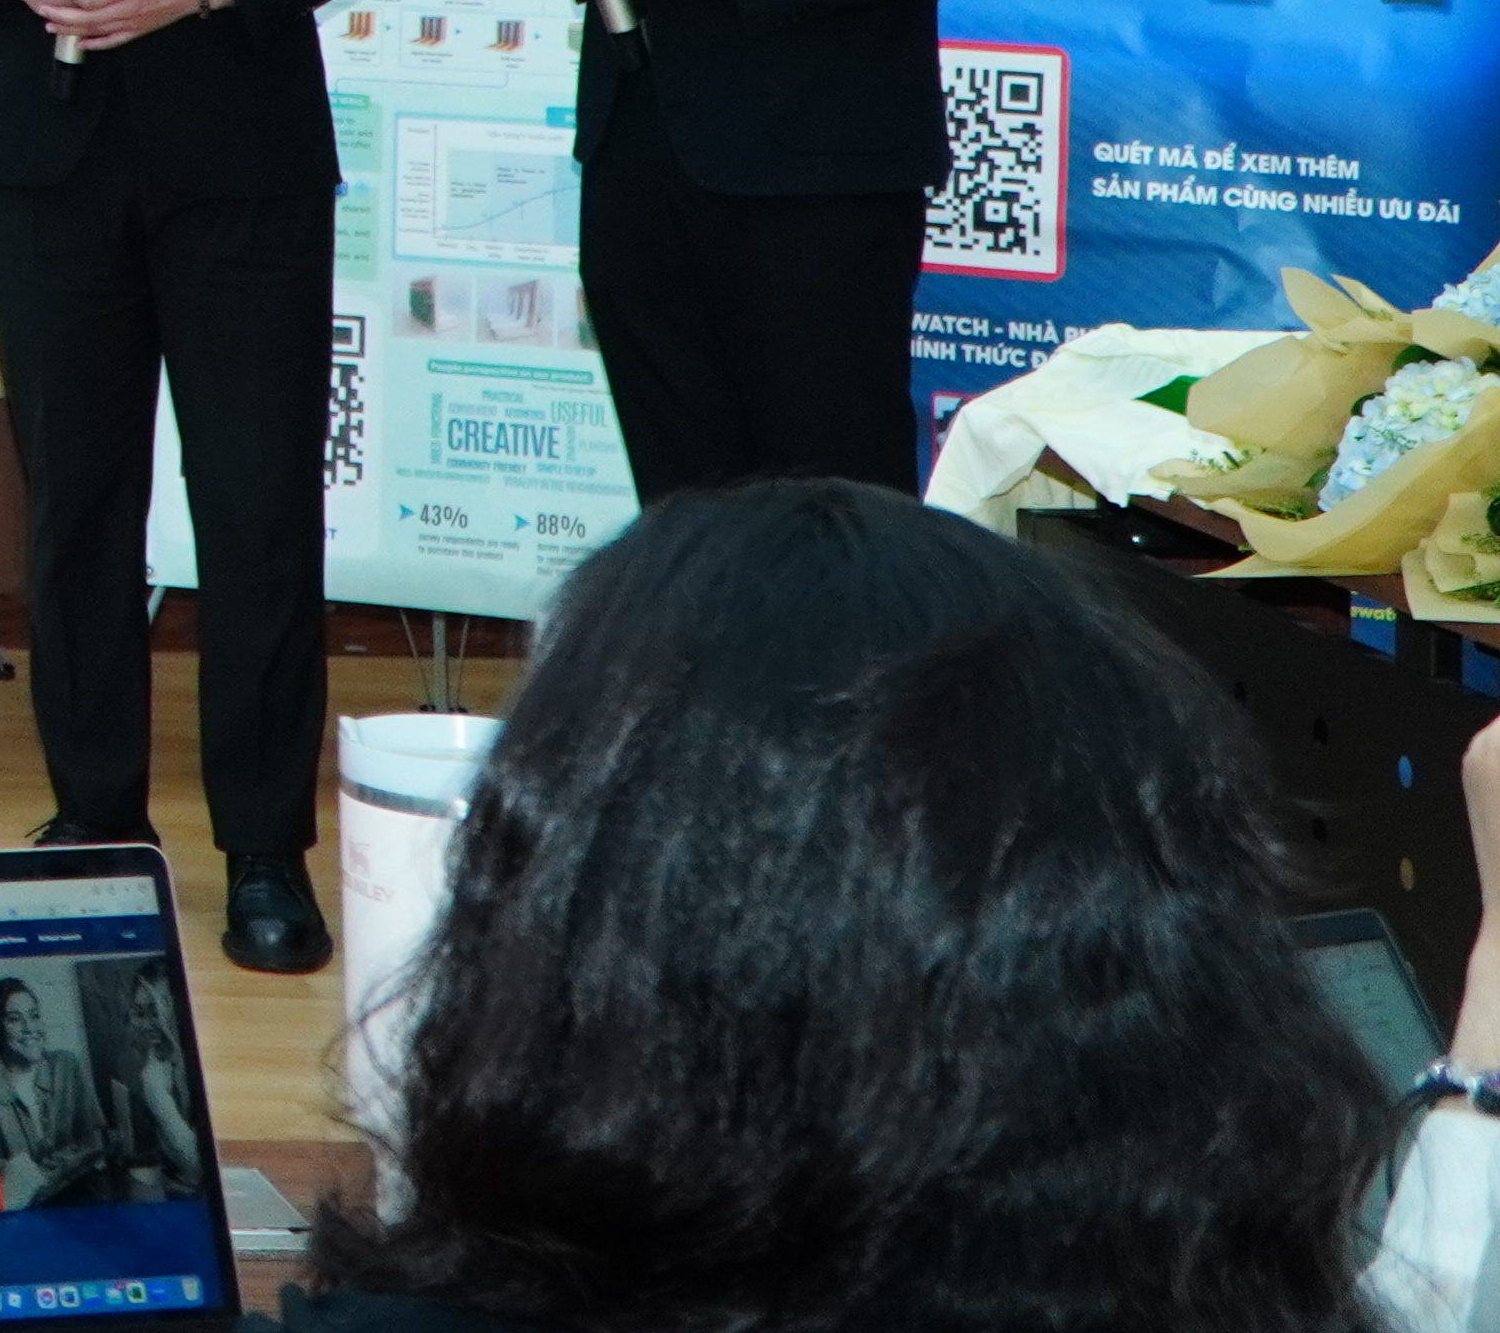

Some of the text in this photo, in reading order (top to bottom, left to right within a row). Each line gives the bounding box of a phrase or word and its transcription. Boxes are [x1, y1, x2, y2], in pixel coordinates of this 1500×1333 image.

[1094, 142, 1154, 170] QUÉT
[1241, 152, 1291, 174] XEM
[1297, 151, 1359, 179] THÊM
[447, 418, 560, 459] CREATIVE
[420, 504, 468, 529] 43%
[537, 513, 586, 538] 88%
